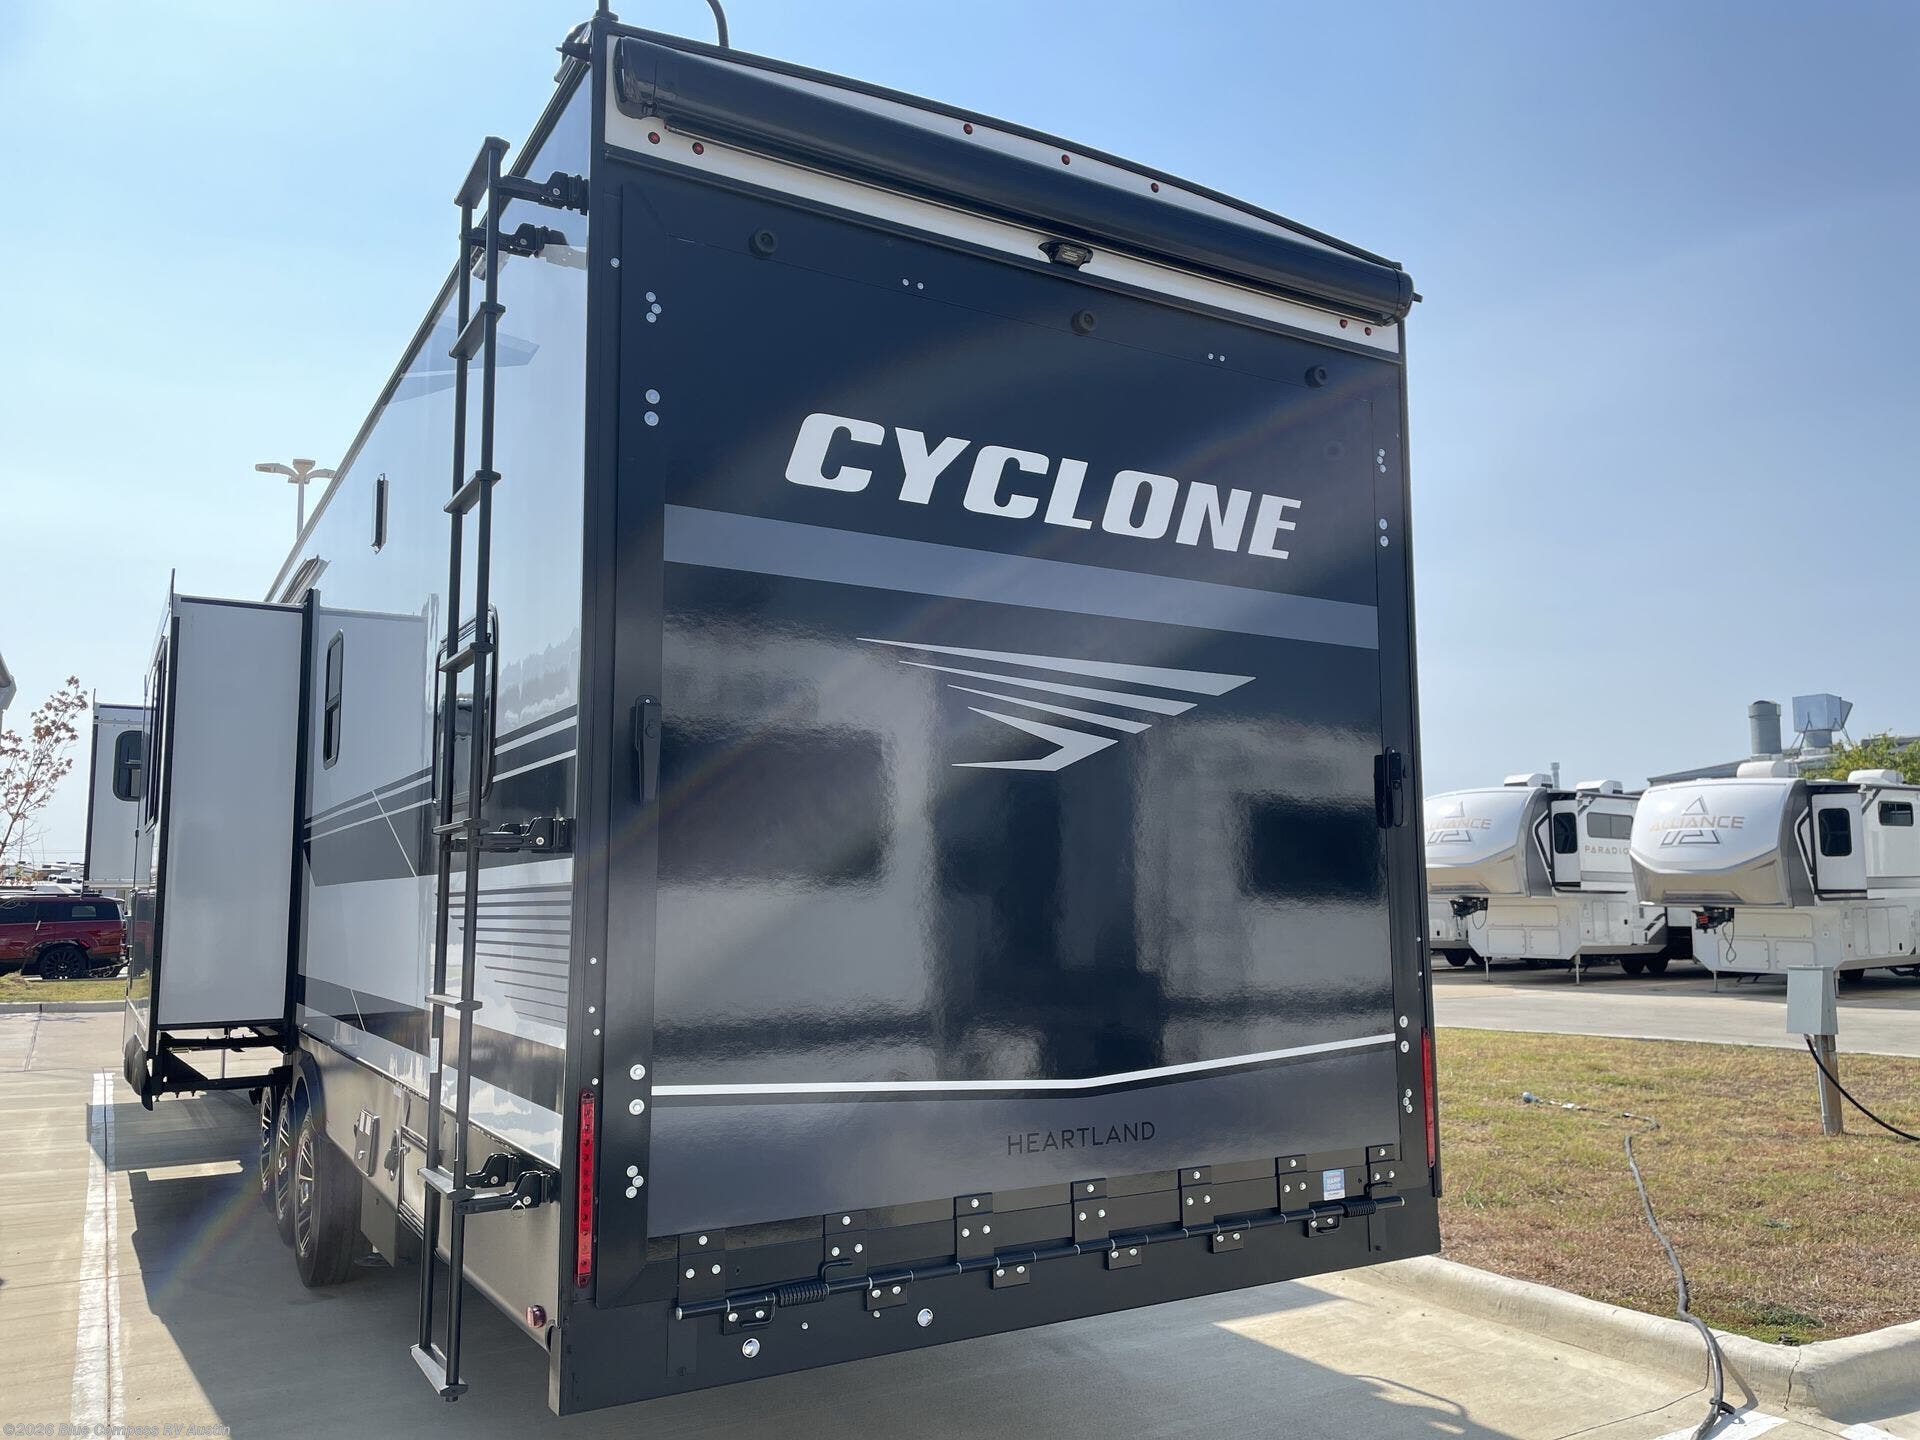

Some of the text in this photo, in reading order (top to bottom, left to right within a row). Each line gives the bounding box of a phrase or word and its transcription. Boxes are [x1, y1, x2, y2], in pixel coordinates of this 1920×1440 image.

[785, 412, 1302, 560] CYCLONE
[1649, 815, 1744, 832] ALLIANCE
[1007, 1121, 1155, 1156] HEARTLAND
